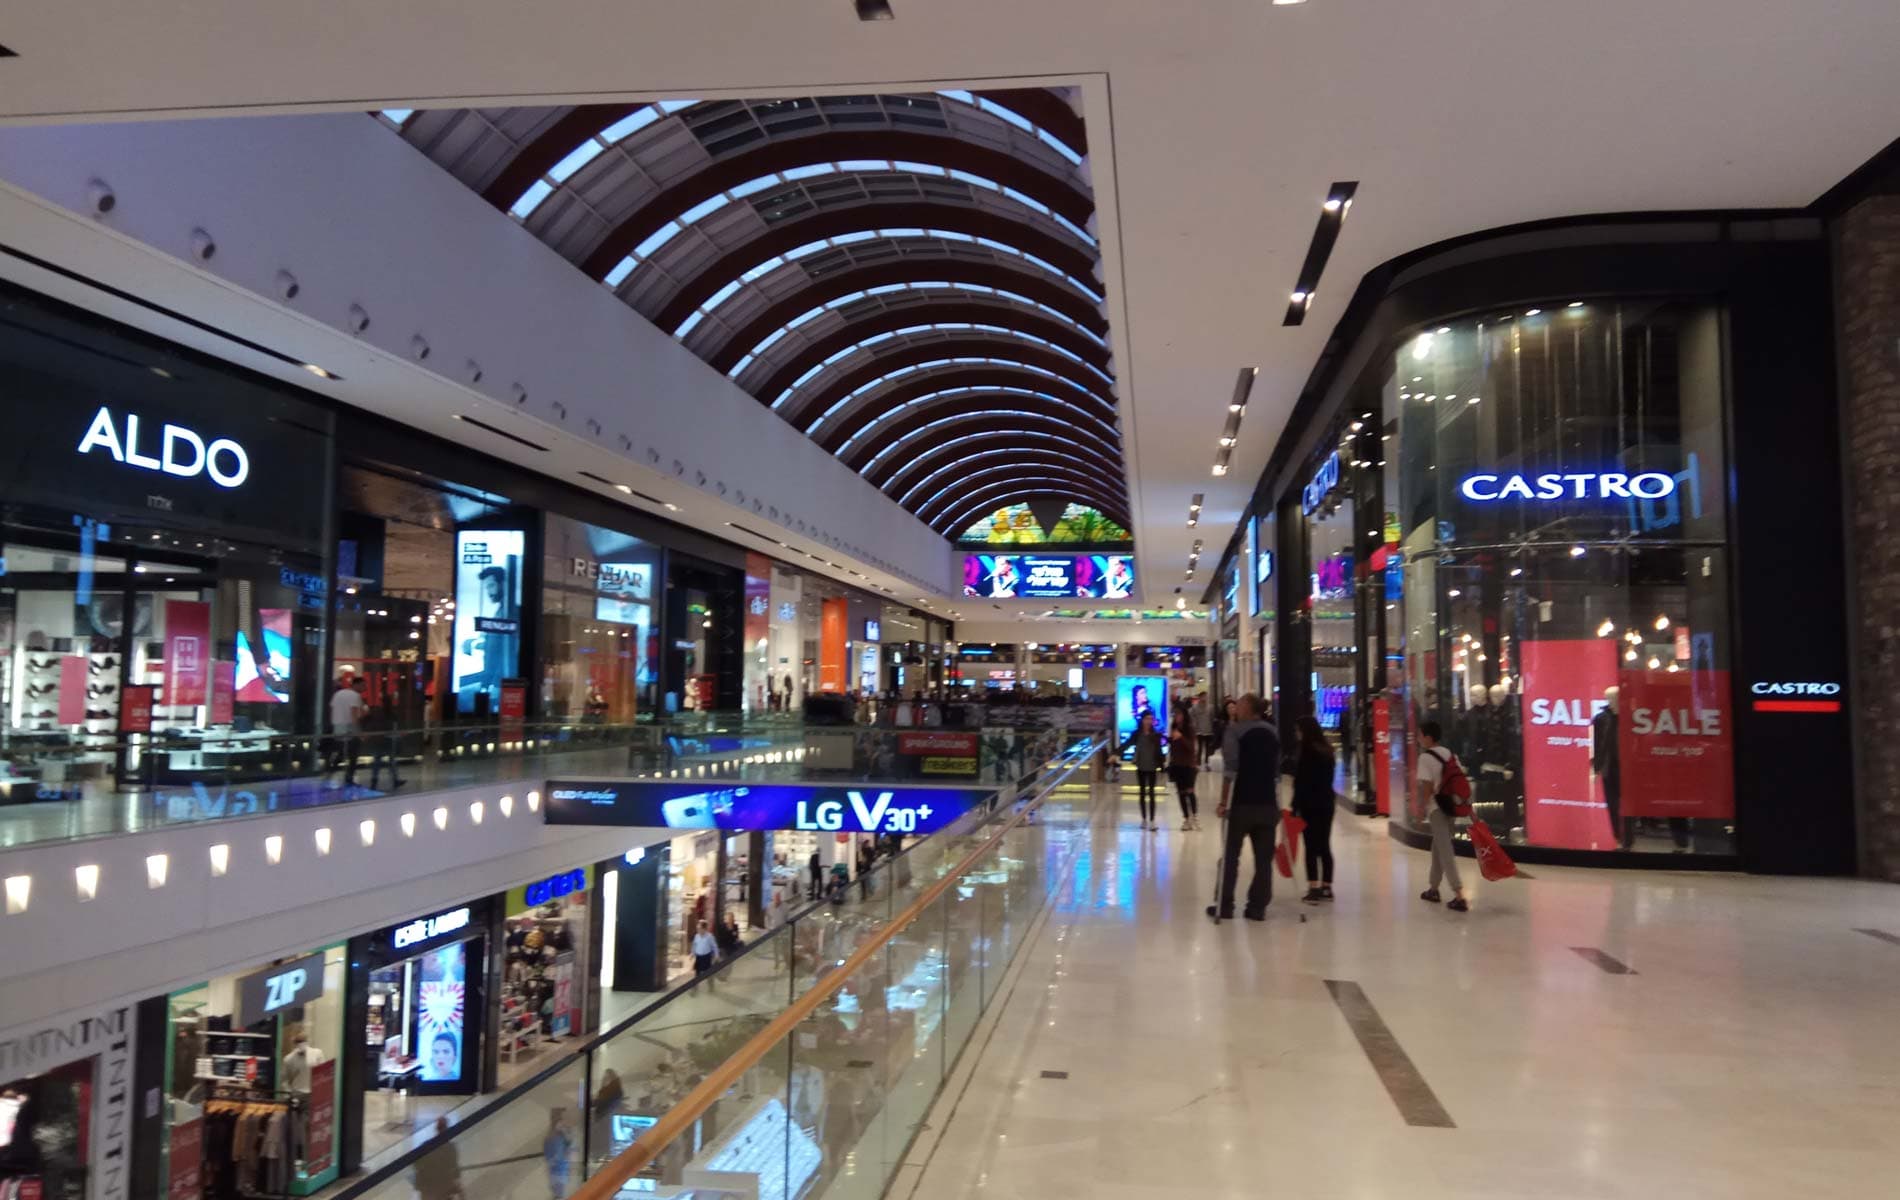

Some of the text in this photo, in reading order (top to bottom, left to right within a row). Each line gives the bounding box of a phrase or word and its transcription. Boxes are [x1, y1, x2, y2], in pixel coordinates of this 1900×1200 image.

[78, 407, 249, 487] ALDO
[1462, 473, 1674, 500] CASTRO
[1751, 682, 1840, 694] CASTRO
[1631, 708, 1721, 735] SALE
[797, 792, 933, 832] LG V30+
[264, 968, 309, 1012] ZIP
